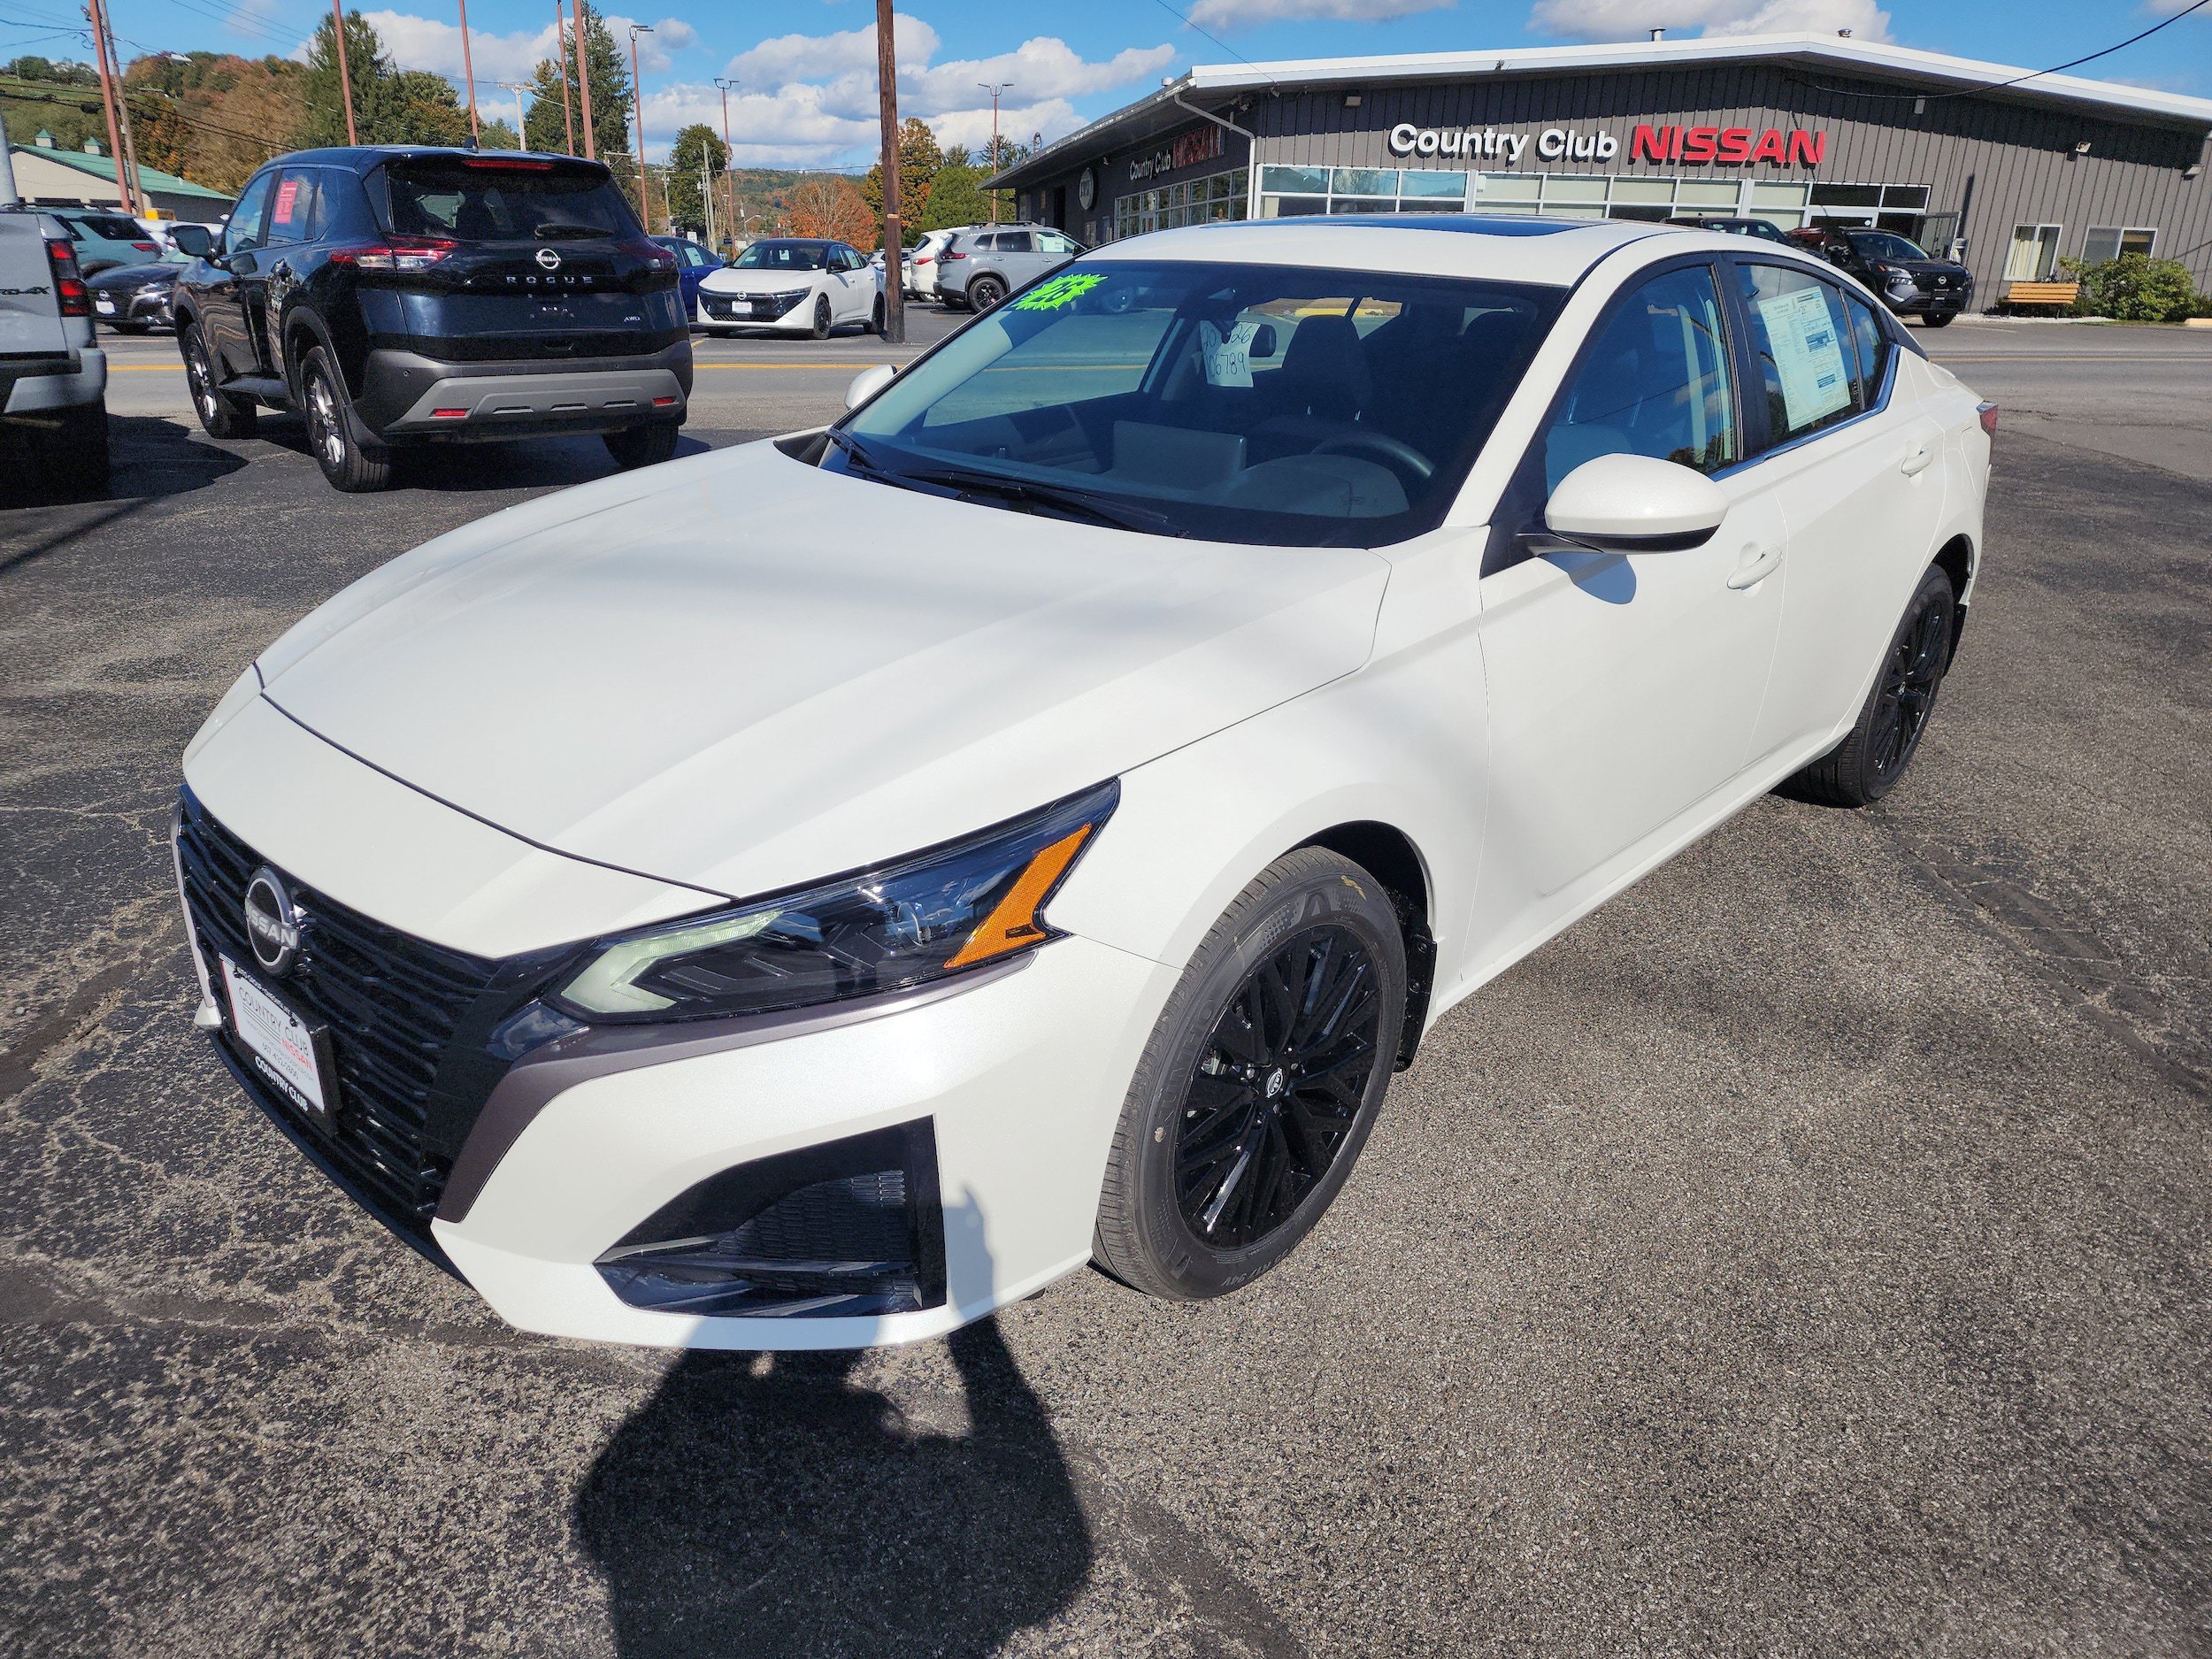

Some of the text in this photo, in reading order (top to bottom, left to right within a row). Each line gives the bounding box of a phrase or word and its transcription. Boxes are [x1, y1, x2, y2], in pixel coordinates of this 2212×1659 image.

[1129, 157, 1154, 181] Country
[1155, 149, 1171, 174] Club
[1388, 123, 1826, 165] Country Club NISSAN
[238, 986, 282, 1033] COUNTRY
[284, 1025, 309, 1056] CLUB
[281, 1037, 312, 1071] NISSAN
[254, 1055, 309, 1112] COUNTRY CLUB
